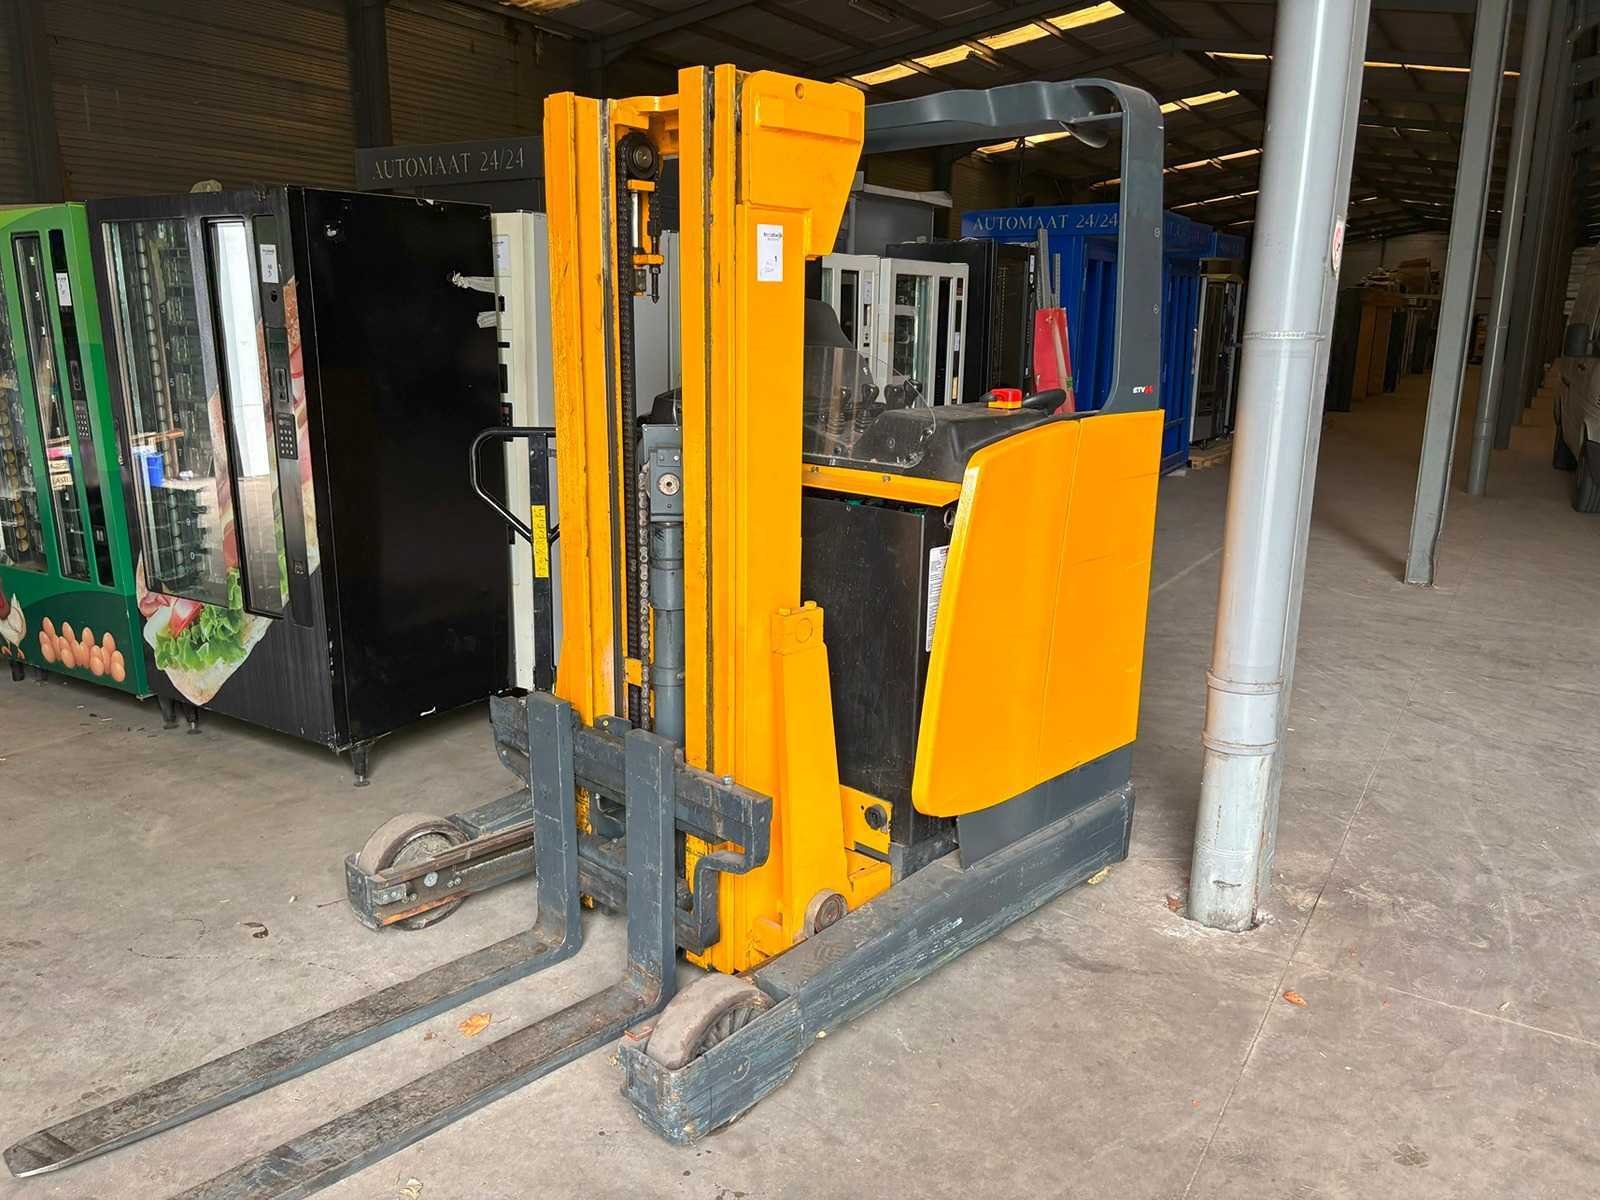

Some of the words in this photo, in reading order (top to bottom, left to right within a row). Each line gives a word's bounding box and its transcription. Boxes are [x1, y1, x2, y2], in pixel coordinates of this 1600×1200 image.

[373, 152, 471, 181] AUTOMAAT
[480, 145, 524, 172] 24/24
[973, 214, 1069, 231] AUTOMAAT
[1076, 212, 1119, 228] 24/24
